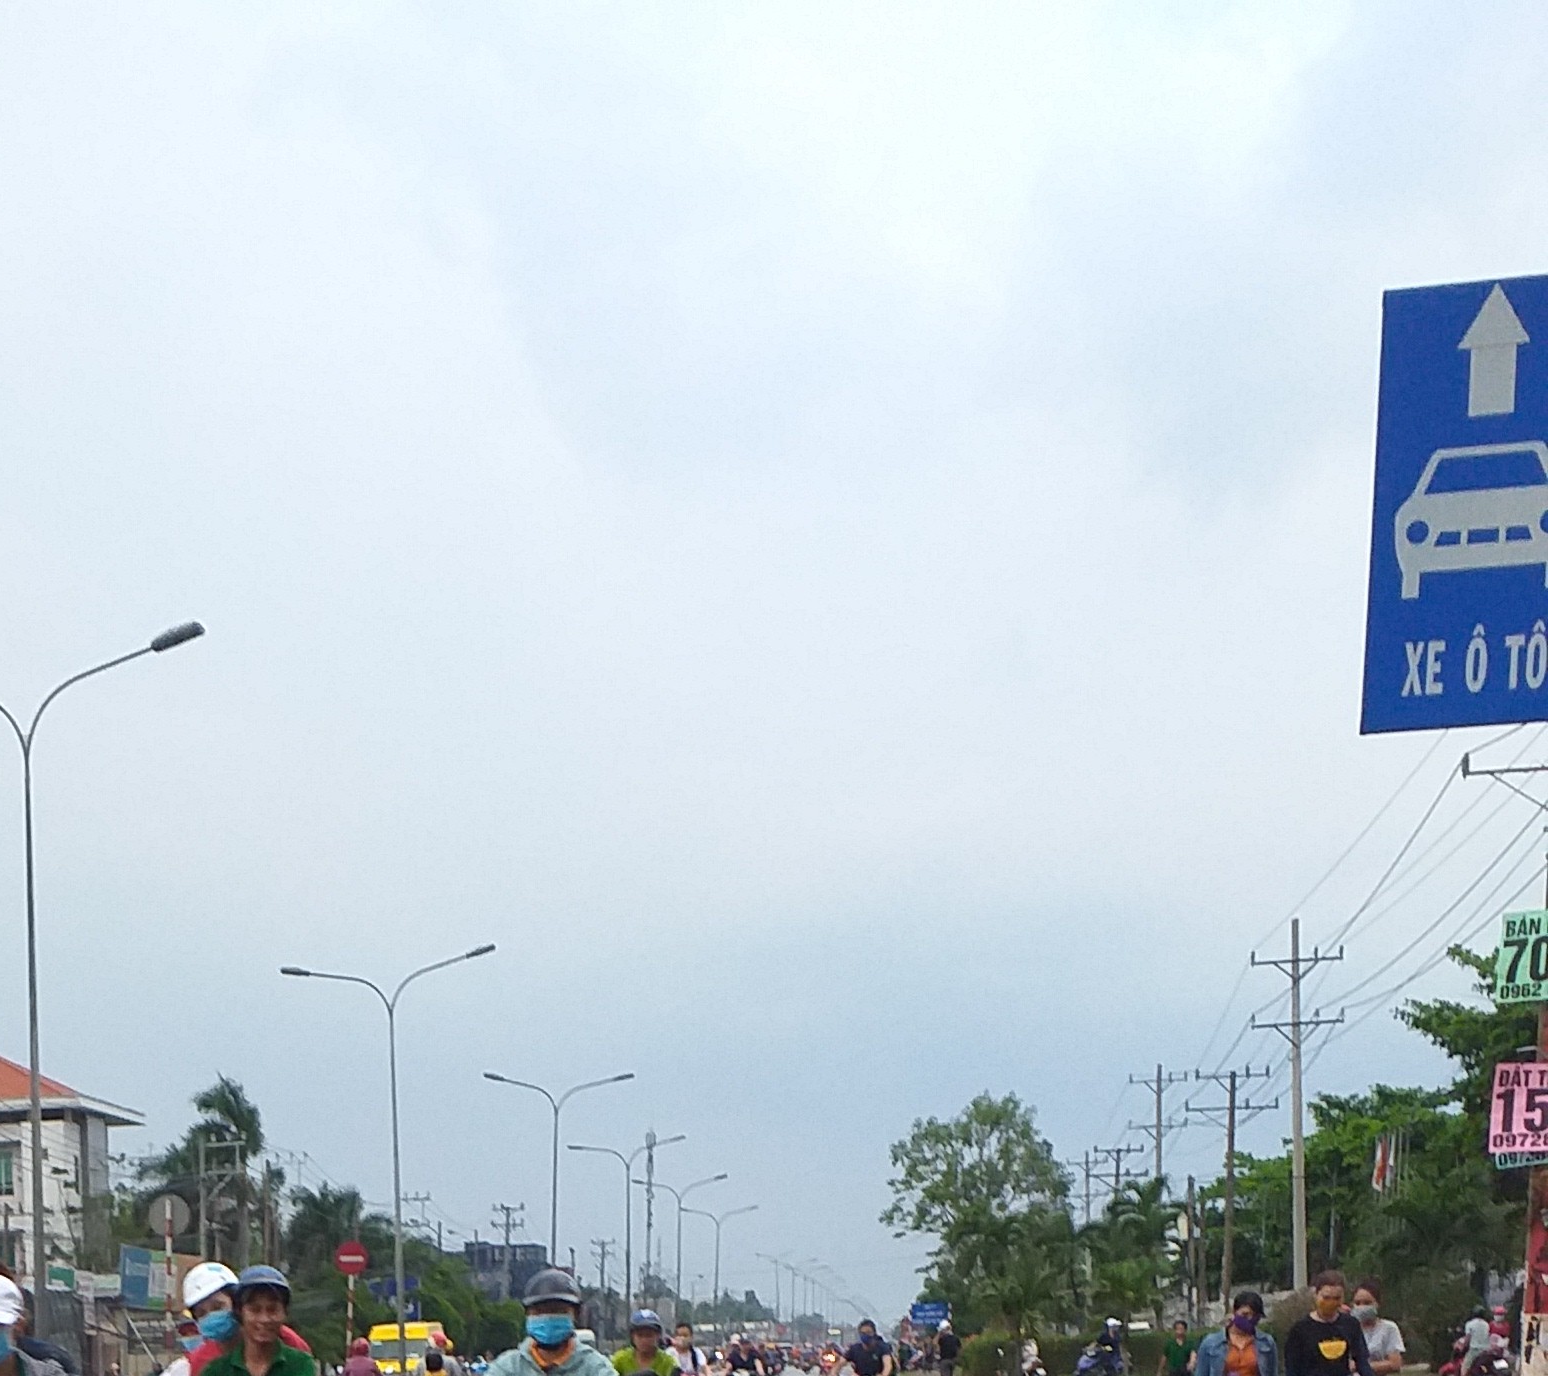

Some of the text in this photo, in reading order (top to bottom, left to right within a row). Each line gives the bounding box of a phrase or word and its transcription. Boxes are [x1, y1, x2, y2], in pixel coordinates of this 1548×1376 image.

[1401, 619, 1548, 697] XE Ô TÔ
